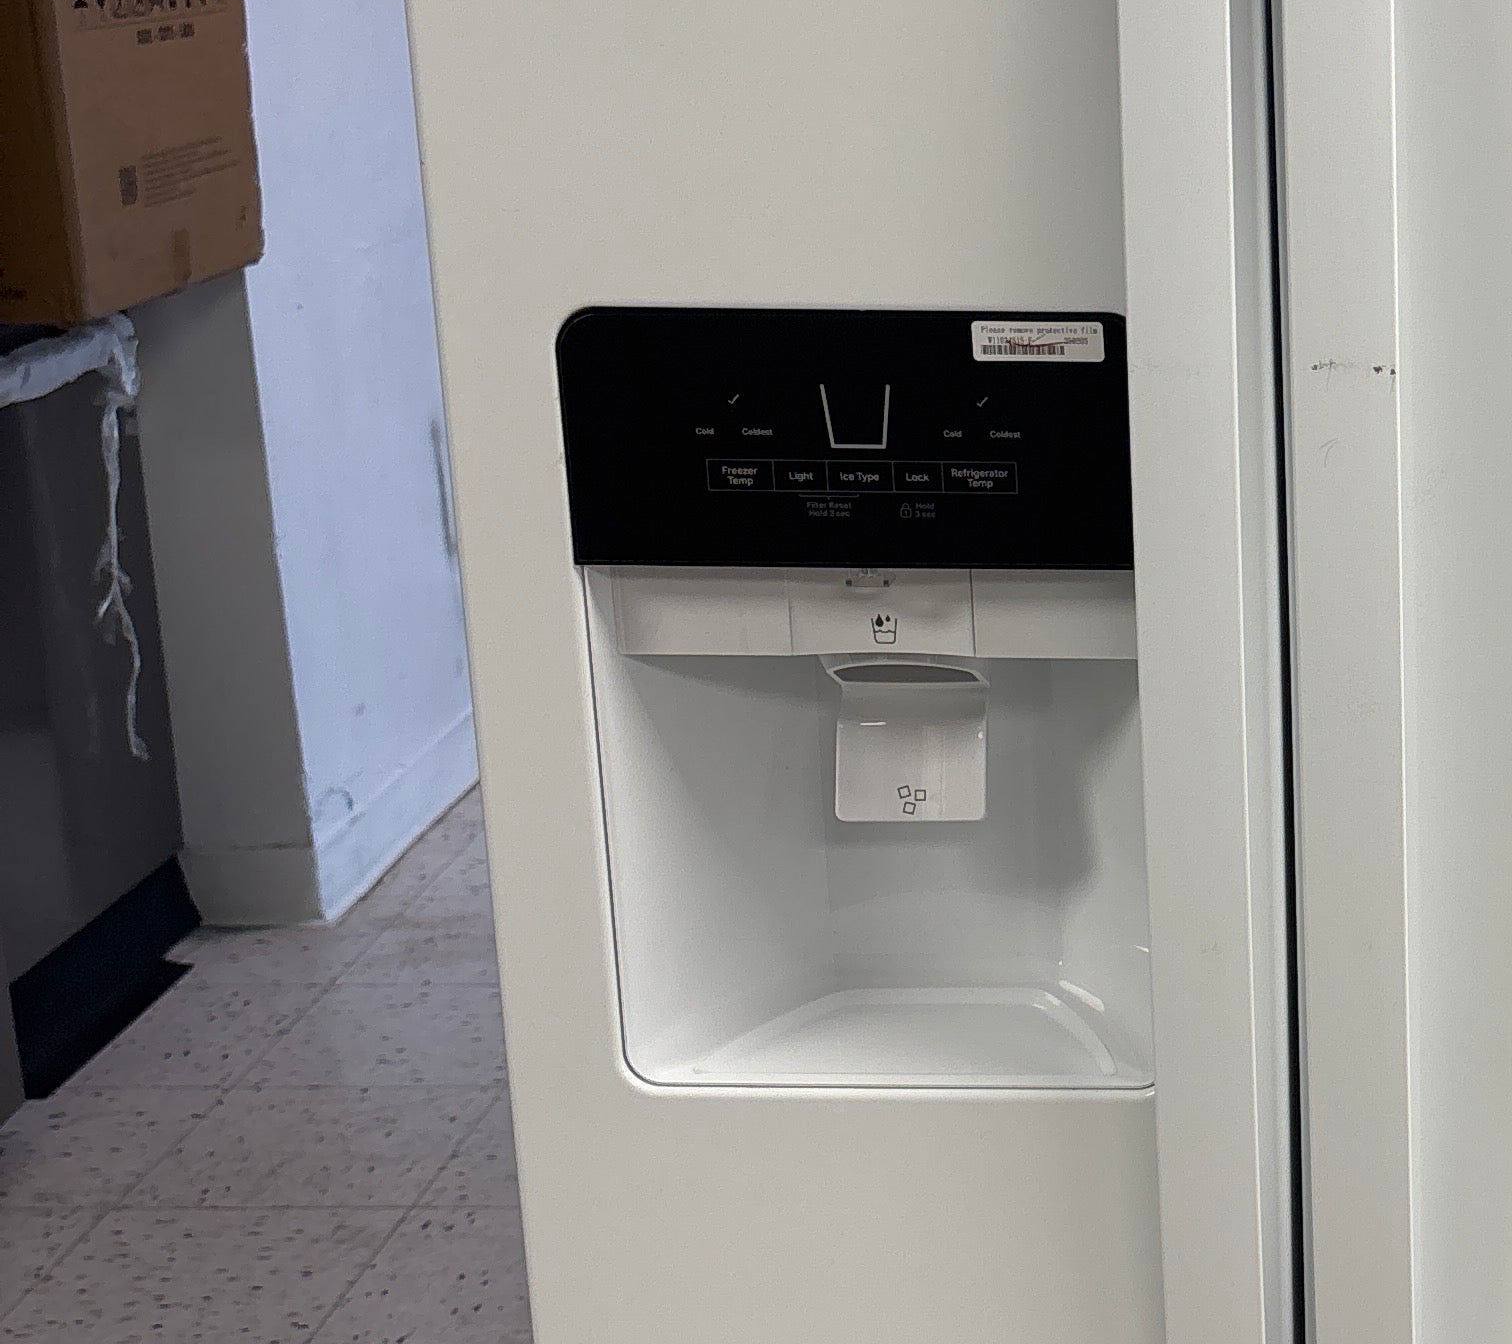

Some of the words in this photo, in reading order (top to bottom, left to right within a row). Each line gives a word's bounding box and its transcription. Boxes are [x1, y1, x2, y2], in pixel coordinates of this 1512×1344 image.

[980, 325, 1006, 334] Please
[1037, 326, 1078, 335] protective
[1081, 325, 1098, 334] film
[695, 427, 715, 436] Cold
[741, 427, 773, 436] Coldest
[943, 429, 963, 438] Cold
[989, 430, 1021, 439] Coldest
[721, 465, 758, 475] Freezer
[951, 467, 1008, 479] Refrigerator
[726, 475, 754, 487] Temp
[788, 471, 814, 482] Light
[840, 471, 855, 481] Ice
[857, 471, 880, 483] Type
[905, 472, 929, 482] Lock
[967, 478, 994, 489] Temp
[915, 502, 936, 510] Hold
